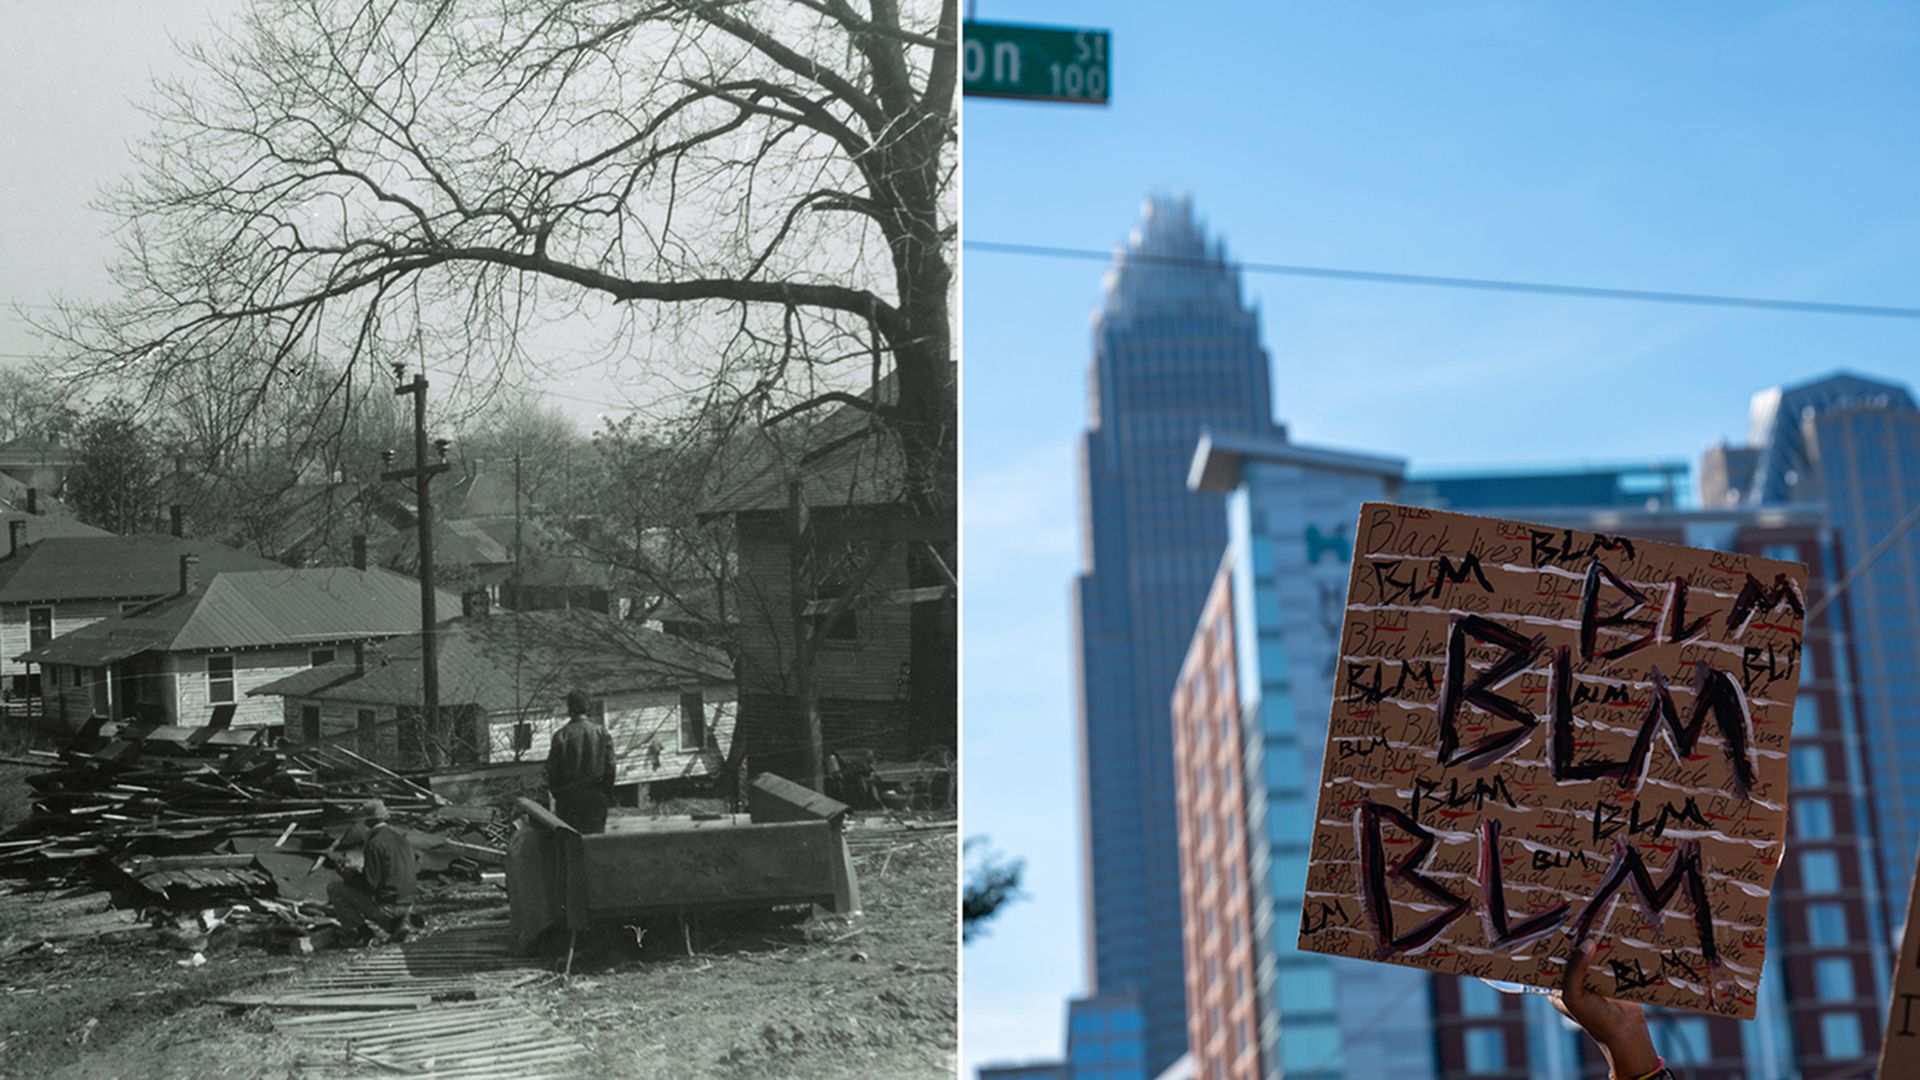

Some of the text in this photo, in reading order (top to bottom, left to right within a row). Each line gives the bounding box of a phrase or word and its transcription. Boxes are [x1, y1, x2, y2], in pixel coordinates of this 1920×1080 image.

[963, 39, 1020, 82] on
[1051, 64, 1106, 98] 100
[1367, 509, 1453, 558] Black
[1469, 528, 1523, 563] lives
[1530, 529, 1635, 568] BLM
[1372, 551, 1495, 607] BLM
[1688, 566, 1733, 590] lives
[1711, 553, 1749, 569] BLM
[1537, 573, 1583, 595] BLM
[1374, 610, 1409, 629] BLM
[1579, 559, 1806, 661] BLM
[1345, 622, 1406, 661] Black
[1343, 659, 1436, 704] BLM
[1332, 710, 1393, 737] matter
[1437, 613, 1758, 799] BLM
[1339, 737, 1392, 760] BLM
[1383, 750, 1417, 770] BLM
[1501, 761, 1539, 783] BLM
[1650, 752, 1710, 788] Black
[1411, 774, 1517, 821] BLM
[1593, 796, 1714, 846] BLM
[1729, 816, 1775, 841] lives
[1532, 850, 1589, 870] BLM
[1354, 797, 1717, 962] BLM
[1554, 870, 1592, 898] lives
[1608, 949, 1701, 992] BLM
